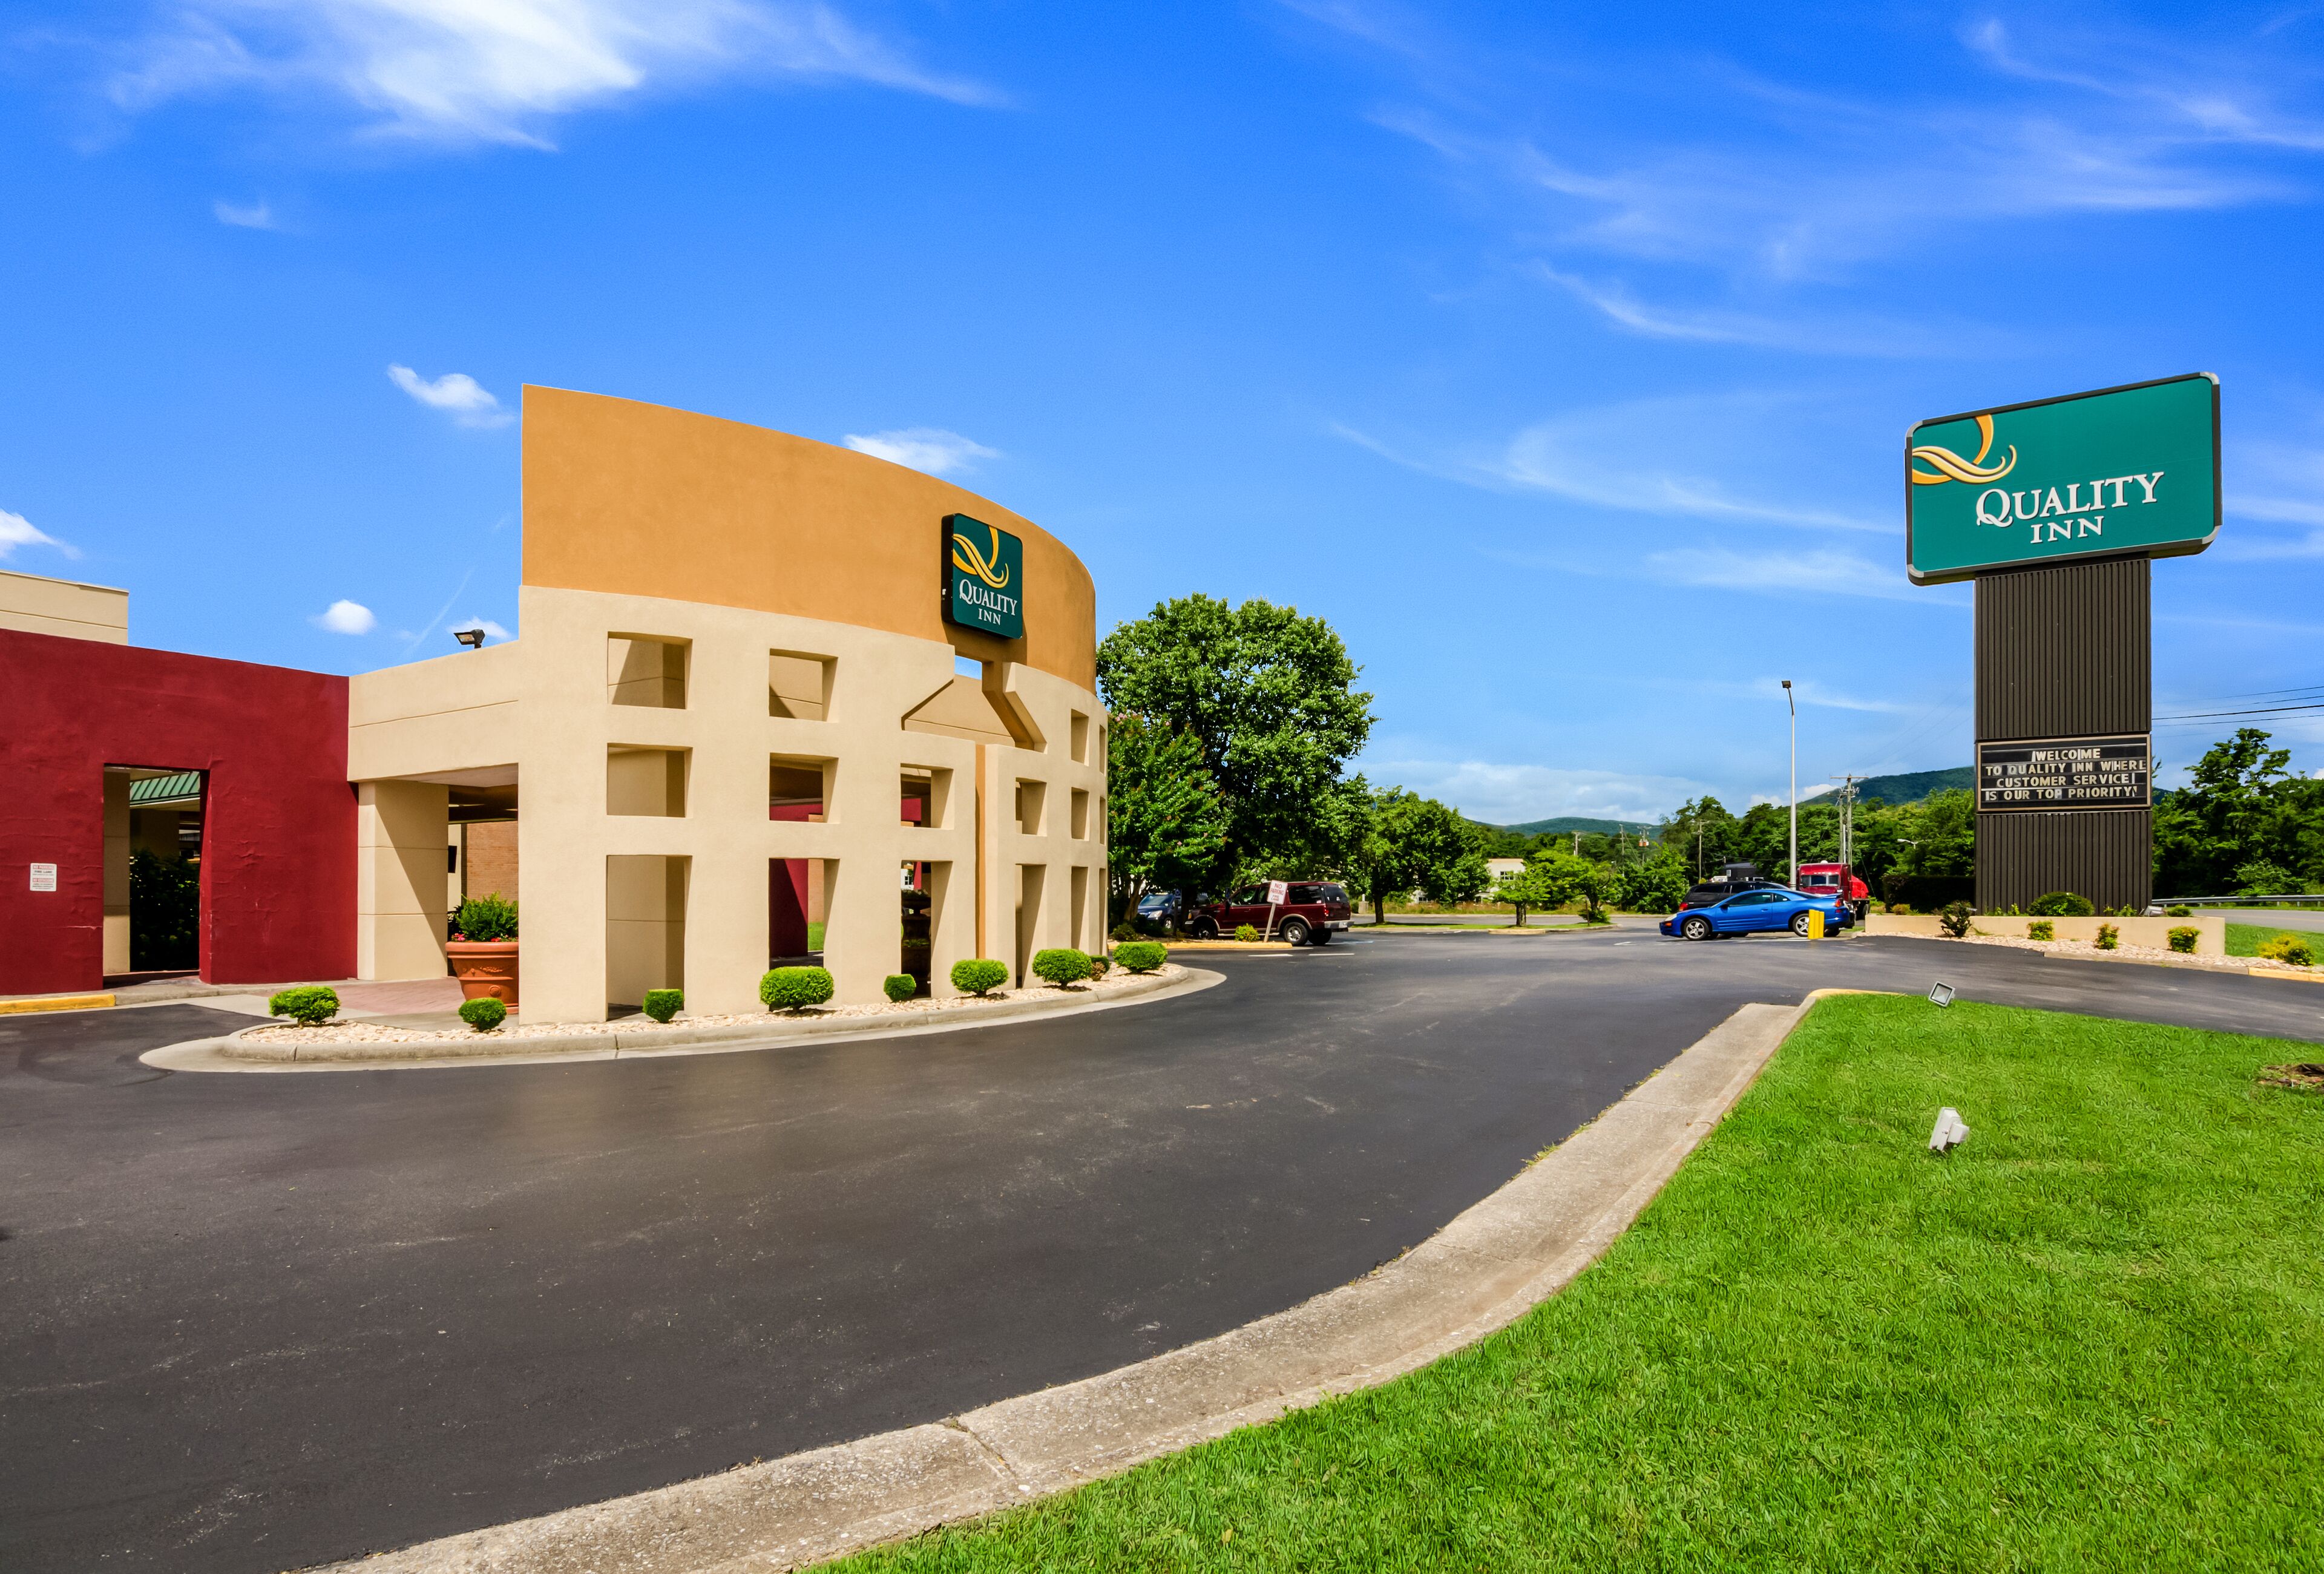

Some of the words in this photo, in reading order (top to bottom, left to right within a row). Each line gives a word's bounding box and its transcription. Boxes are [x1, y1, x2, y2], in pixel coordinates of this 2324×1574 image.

[1976, 472, 2164, 527] QUALITY
[2030, 516, 2104, 543] INN
[959, 579, 1017, 615] QUALITY
[978, 608, 1001, 625] INN
[2035, 749, 2100, 761] WELCOME
[1986, 766, 2002, 776] TO
[2008, 763, 2066, 775] QUALITY
[2072, 762, 2093, 773] INN
[2100, 760, 2146, 771] WHERE
[1997, 776, 2066, 787] CUSTOMER
[2073, 773, 2129, 785] SERVICE
[1986, 791, 1997, 801] IS
[2004, 790, 2030, 800] OUR
[2037, 789, 2062, 799] TOP
